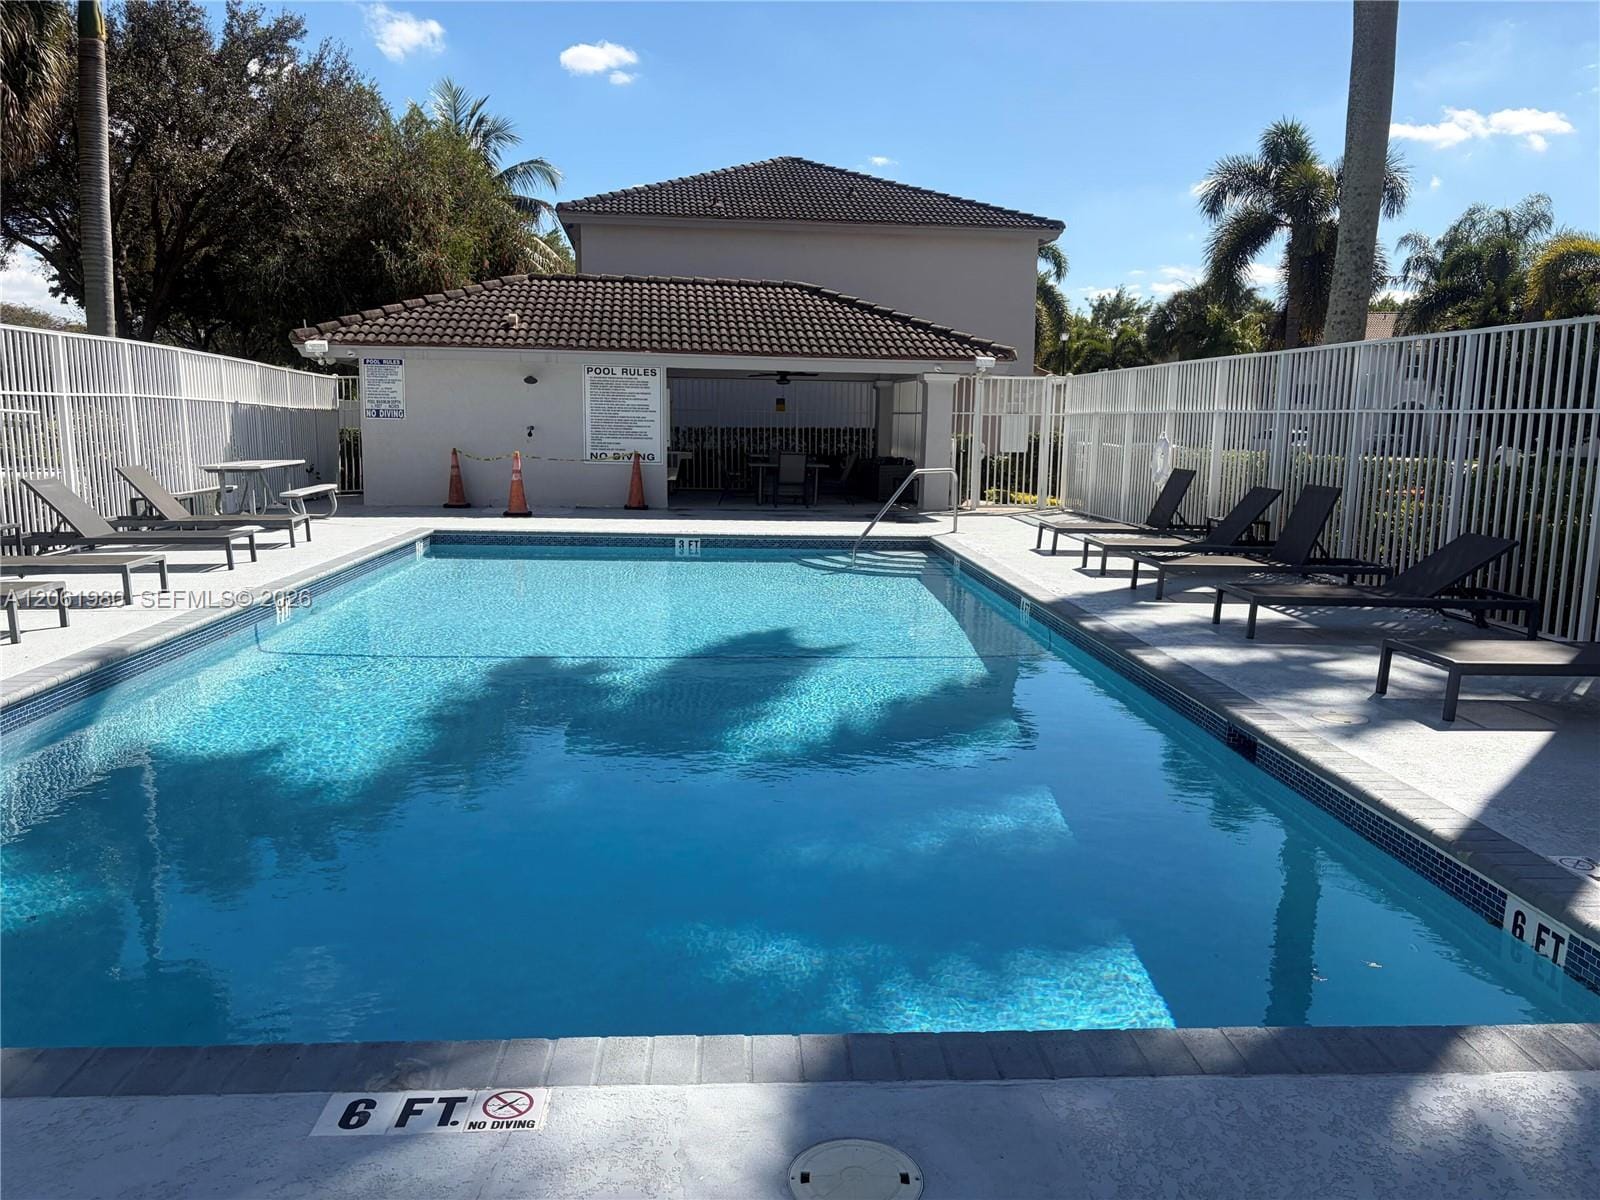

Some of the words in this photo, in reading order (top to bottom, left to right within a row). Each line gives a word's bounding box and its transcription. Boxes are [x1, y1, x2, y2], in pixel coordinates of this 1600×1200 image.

[586, 366, 617, 375] POOL
[621, 367, 657, 377] RULES
[366, 409, 376, 417] NO
[590, 452, 608, 460] NO
[613, 452, 655, 461] DIVNG
[1512, 909, 1526, 942] 6
[1534, 922, 1566, 965] FT
[337, 1098, 377, 1130] 6
[394, 1096, 467, 1128] FT.
[467, 1120, 487, 1130] NO
[490, 1119, 536, 1130] DIVING
